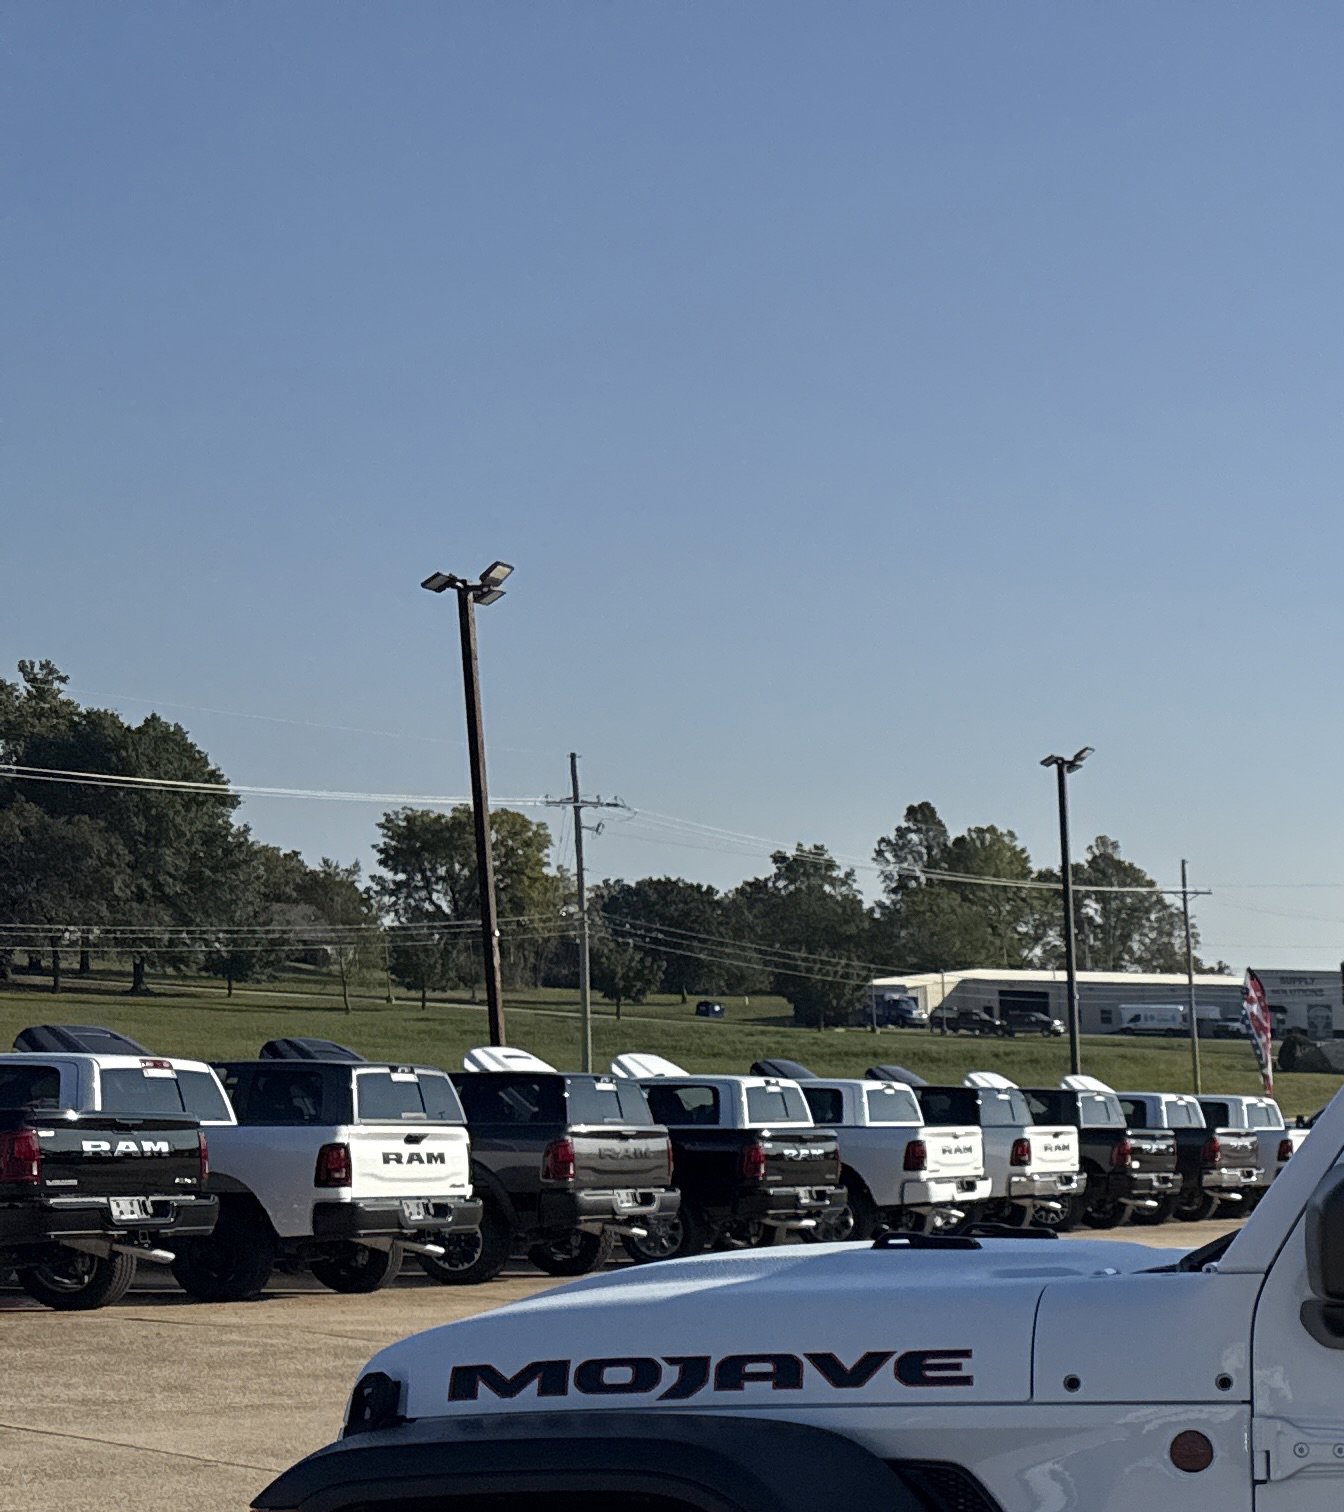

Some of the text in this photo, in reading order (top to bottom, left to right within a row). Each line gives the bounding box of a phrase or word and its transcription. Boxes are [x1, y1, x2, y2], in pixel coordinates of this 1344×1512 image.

[82, 1140, 170, 1157] RAM
[598, 1147, 652, 1160] RAM
[941, 1144, 974, 1155] RAM
[1043, 1143, 1071, 1152] RAM
[382, 1152, 446, 1165] RAM
[447, 1348, 974, 1402] MOJAVE
